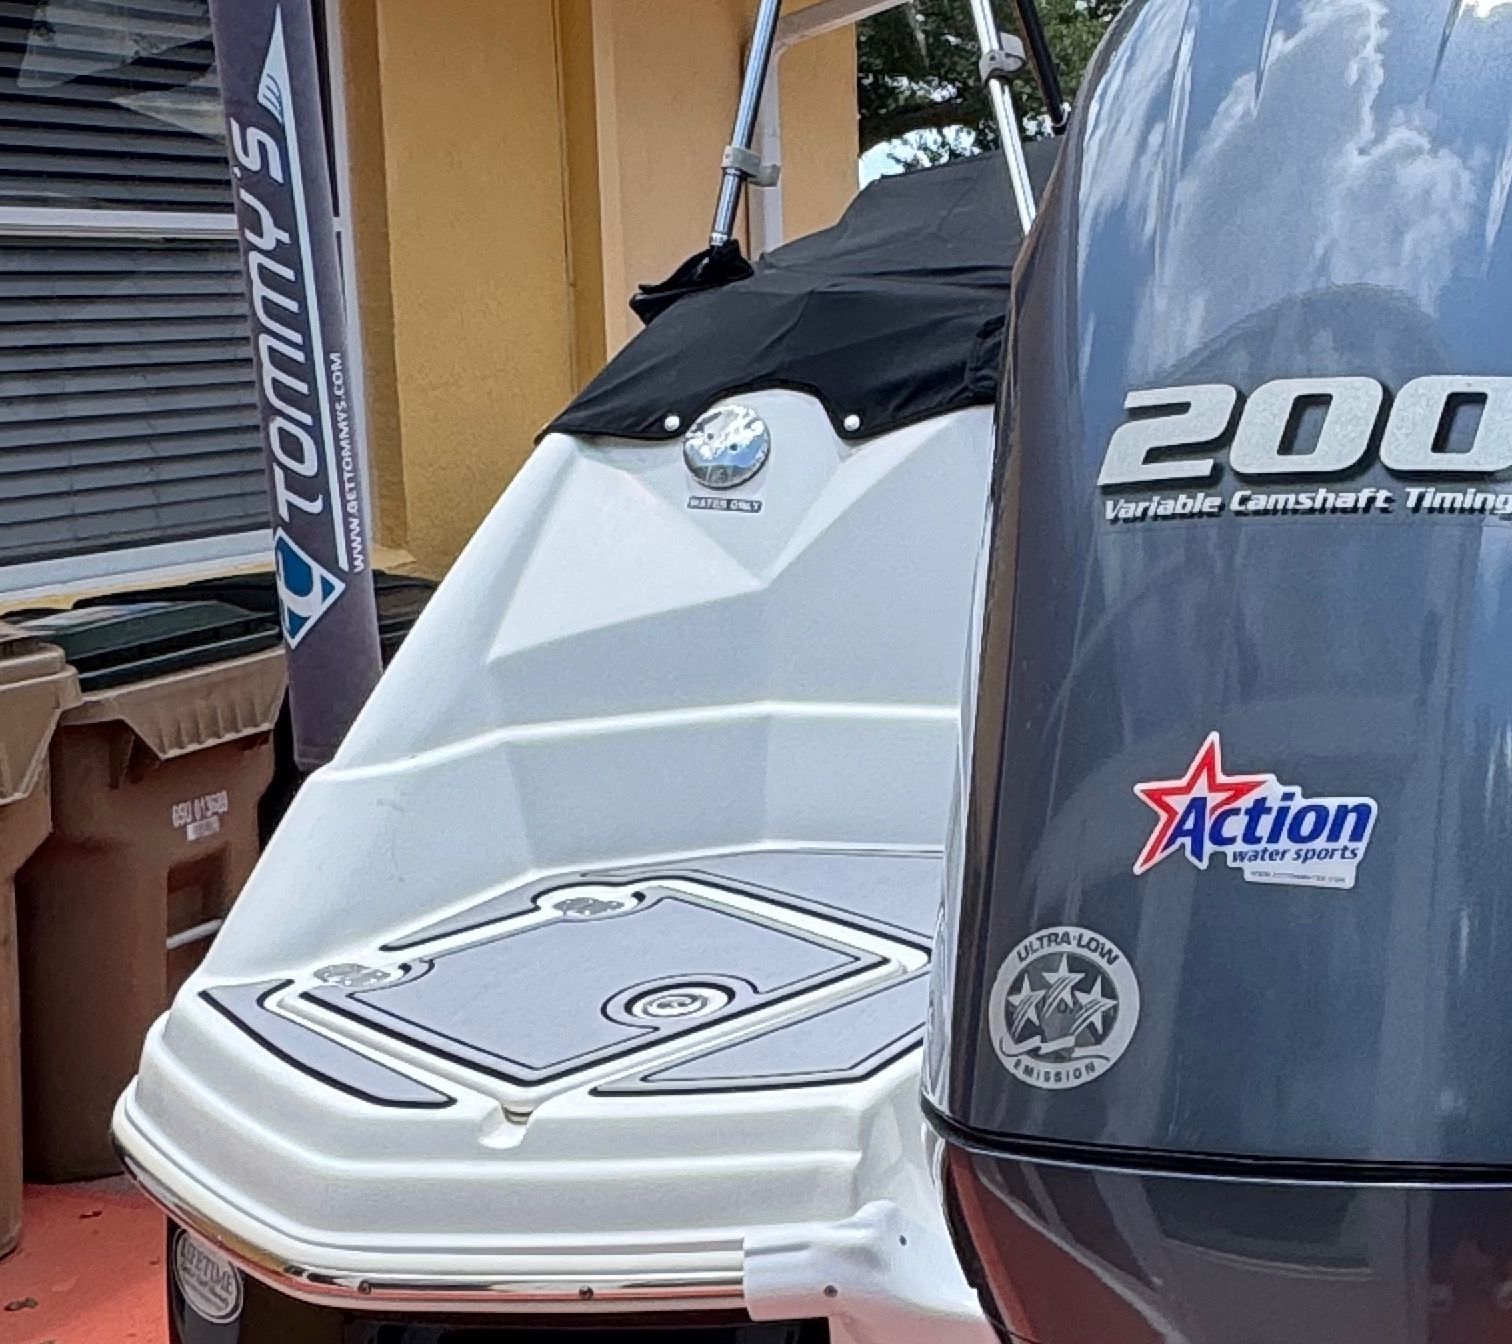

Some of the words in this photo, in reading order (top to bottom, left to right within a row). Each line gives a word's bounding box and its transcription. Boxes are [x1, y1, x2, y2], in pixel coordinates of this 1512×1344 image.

[229, 119, 324, 524] TOMMY'S
[329, 352, 365, 574] WWW.GETTOMMYS.COM
[1104, 493, 1223, 522] Variable
[1230, 487, 1394, 513] Camshaft
[1160, 791, 1373, 863] Action
[1232, 846, 1291, 864] water
[1293, 845, 1360, 864] sports
[1013, 1058, 1097, 1084] EMISSION
